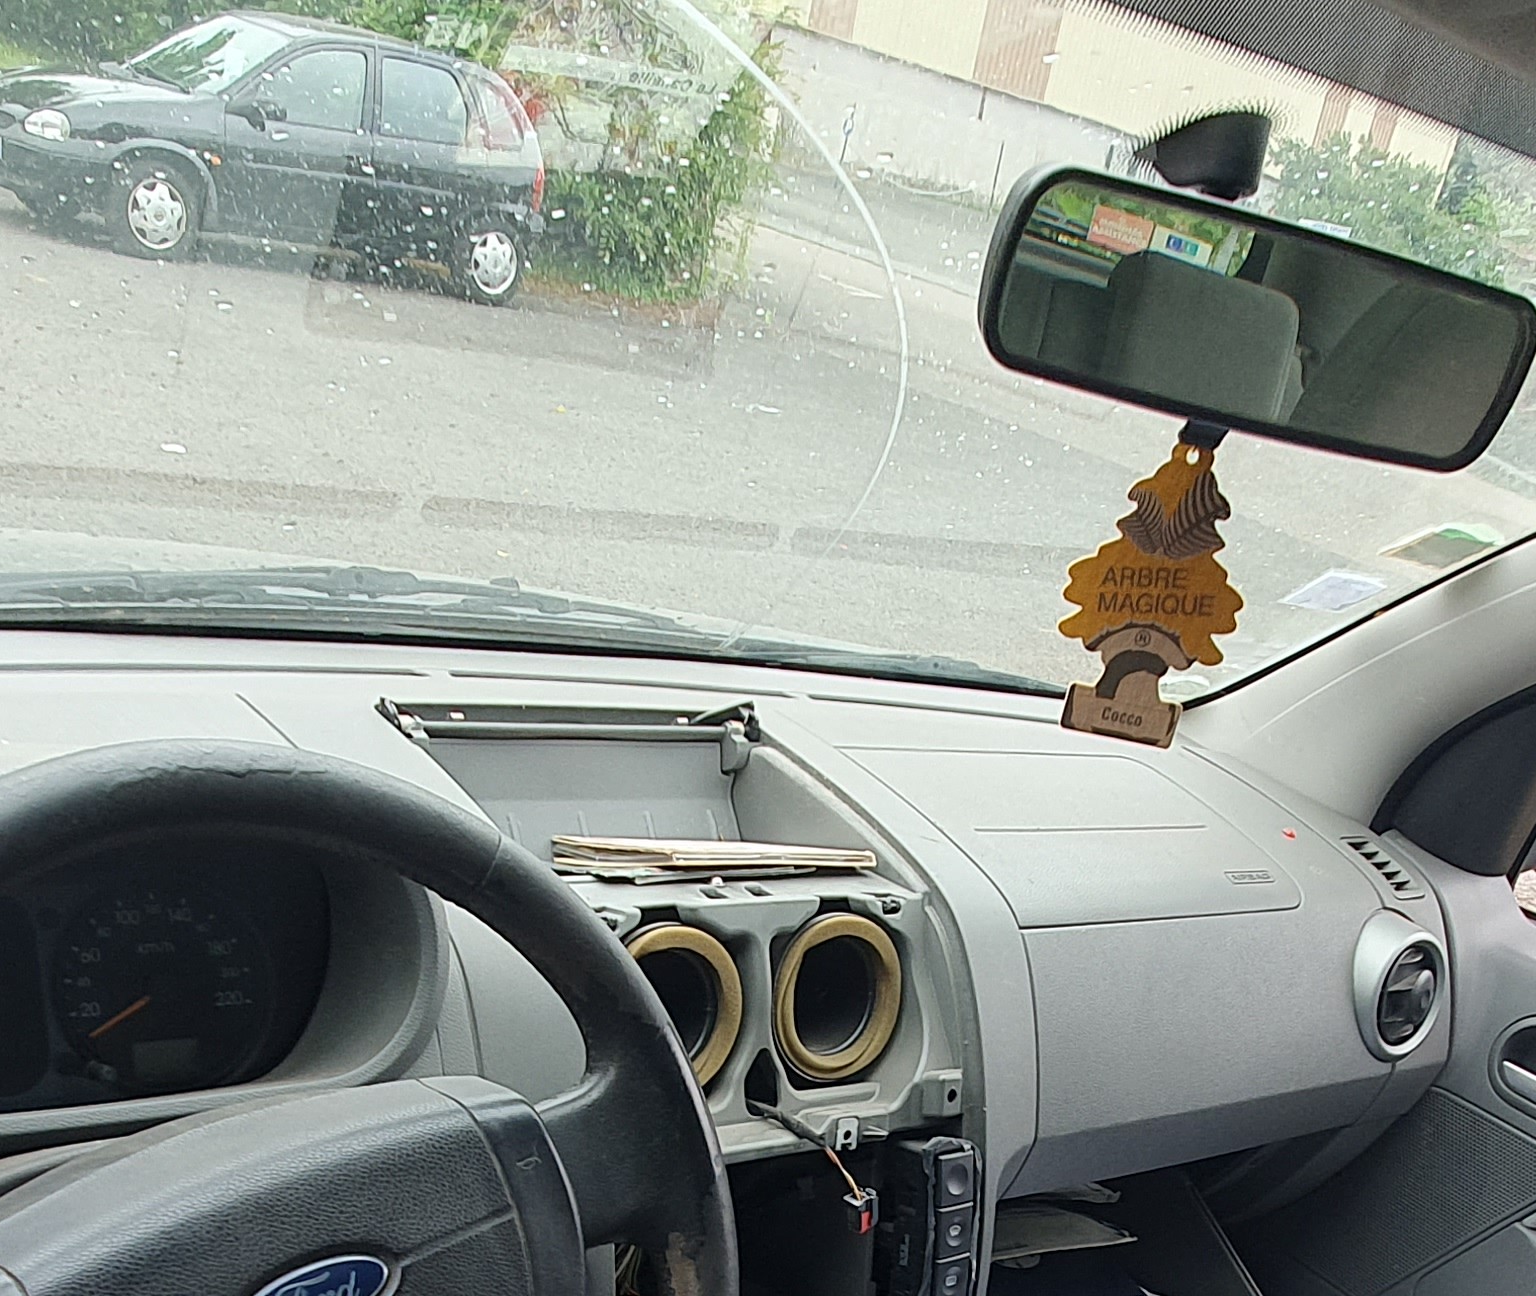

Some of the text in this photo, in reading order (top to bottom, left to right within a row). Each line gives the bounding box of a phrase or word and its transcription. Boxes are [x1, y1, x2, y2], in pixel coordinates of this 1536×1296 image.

[1098, 566, 1188, 589] ARBRE
[1097, 592, 1216, 617] MAGIQUE
[79, 1001, 101, 1018] 20
